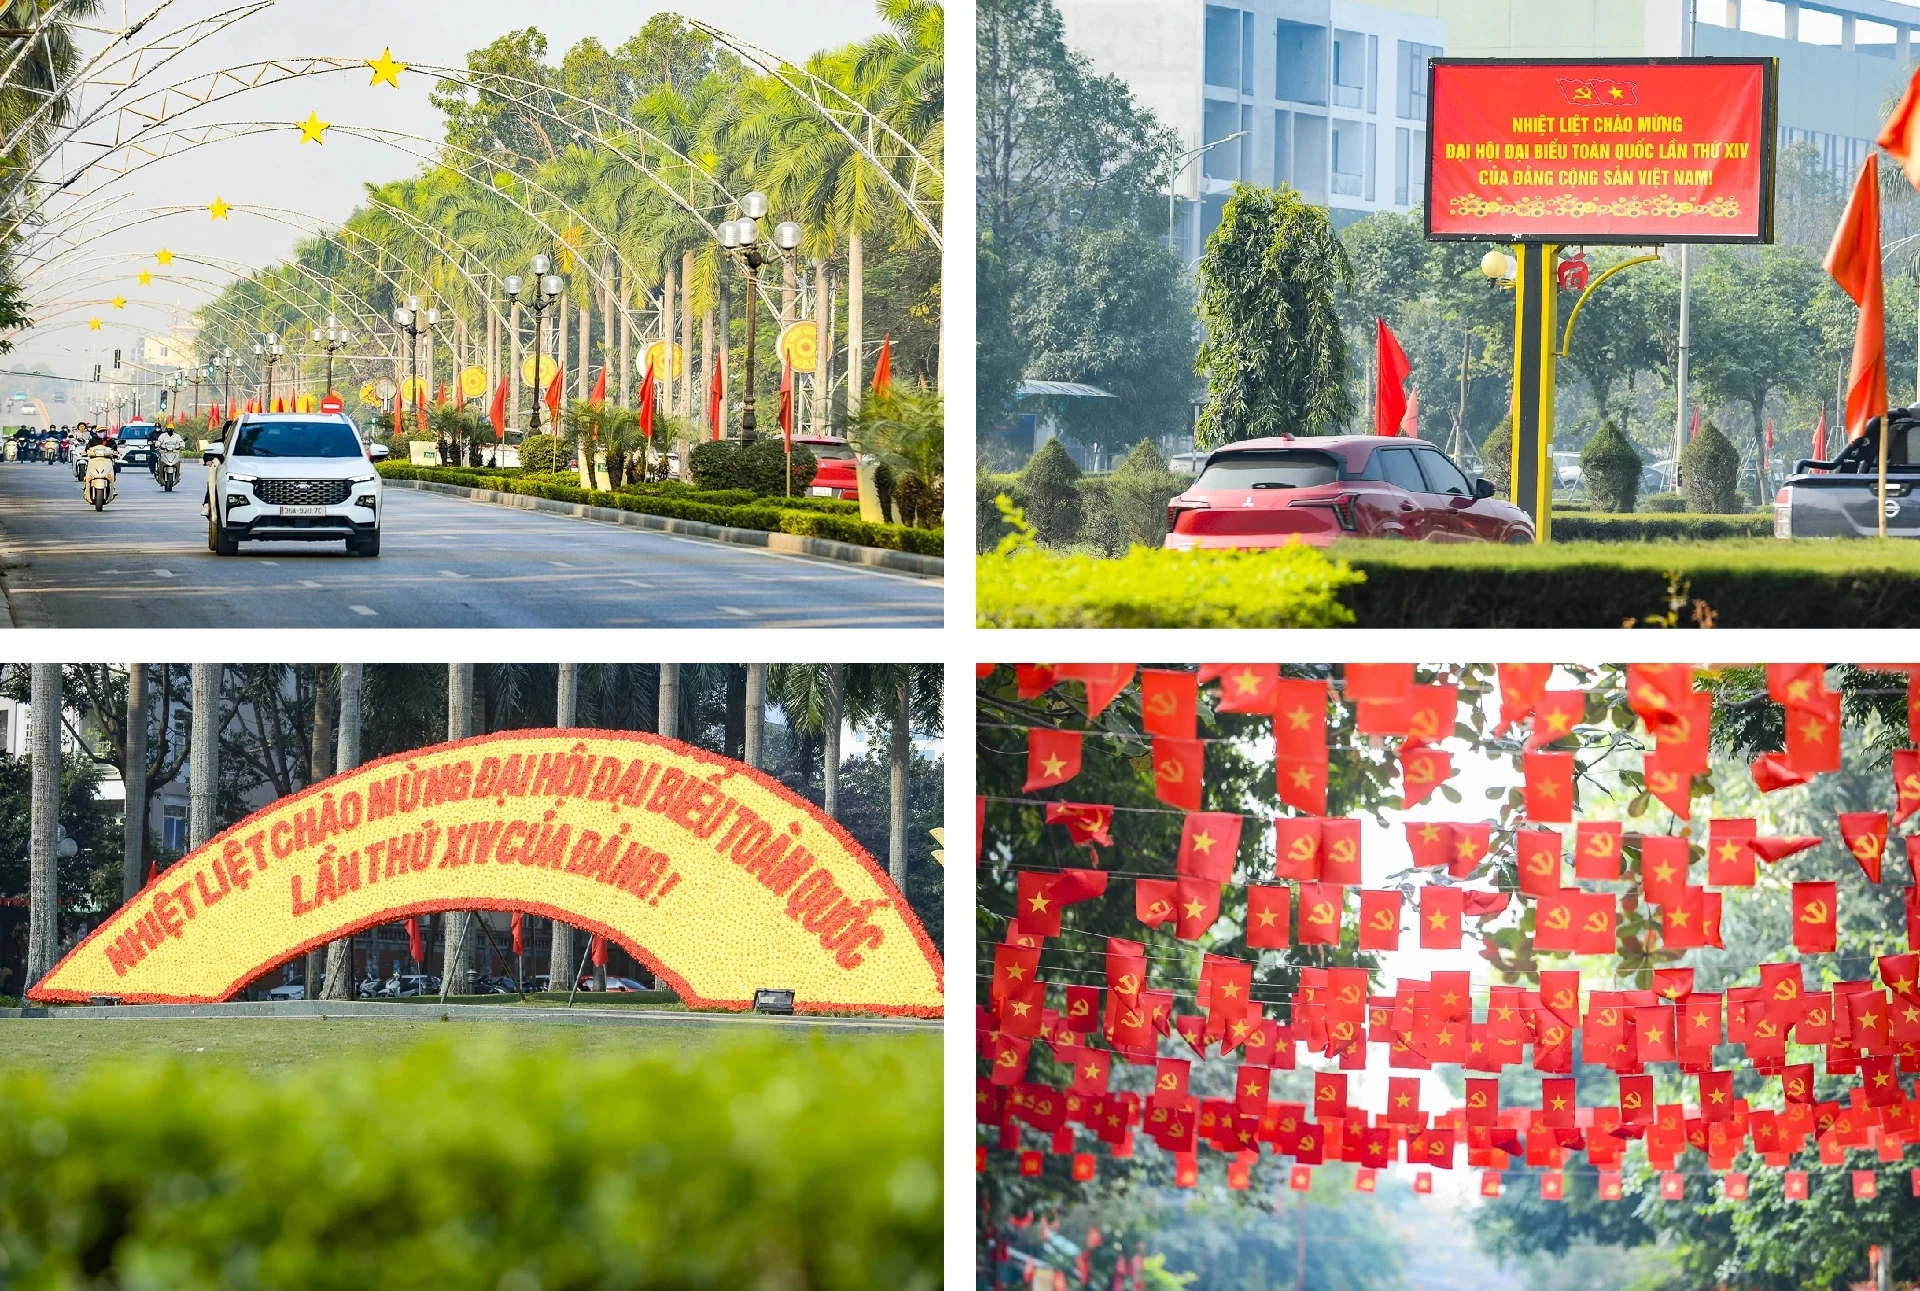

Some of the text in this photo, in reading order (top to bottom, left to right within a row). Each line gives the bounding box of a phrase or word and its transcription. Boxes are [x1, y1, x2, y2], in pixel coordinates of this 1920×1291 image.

[1512, 113, 1683, 136] NHIỆT LIỆT CHÀO MỪNG
[1445, 138, 1749, 163] ĐẠI HỘI ĐẠI BIỂU TOÀN QUỐC LẦN THỨ XIV
[1478, 165, 1713, 189] CỦA ĐẢNG CỘNG SẢN VIỆT NAM!
[104, 742, 892, 977] NHIỆT LIỆT CHÀO MỪNG ĐẠI HỘI ĐẠI BIỂU TOÀN QUỐC
[290, 844, 361, 917] LẦN
[364, 820, 438, 884] THỨ
[437, 817, 500, 870] XIV
[498, 810, 572, 871] CỦA
